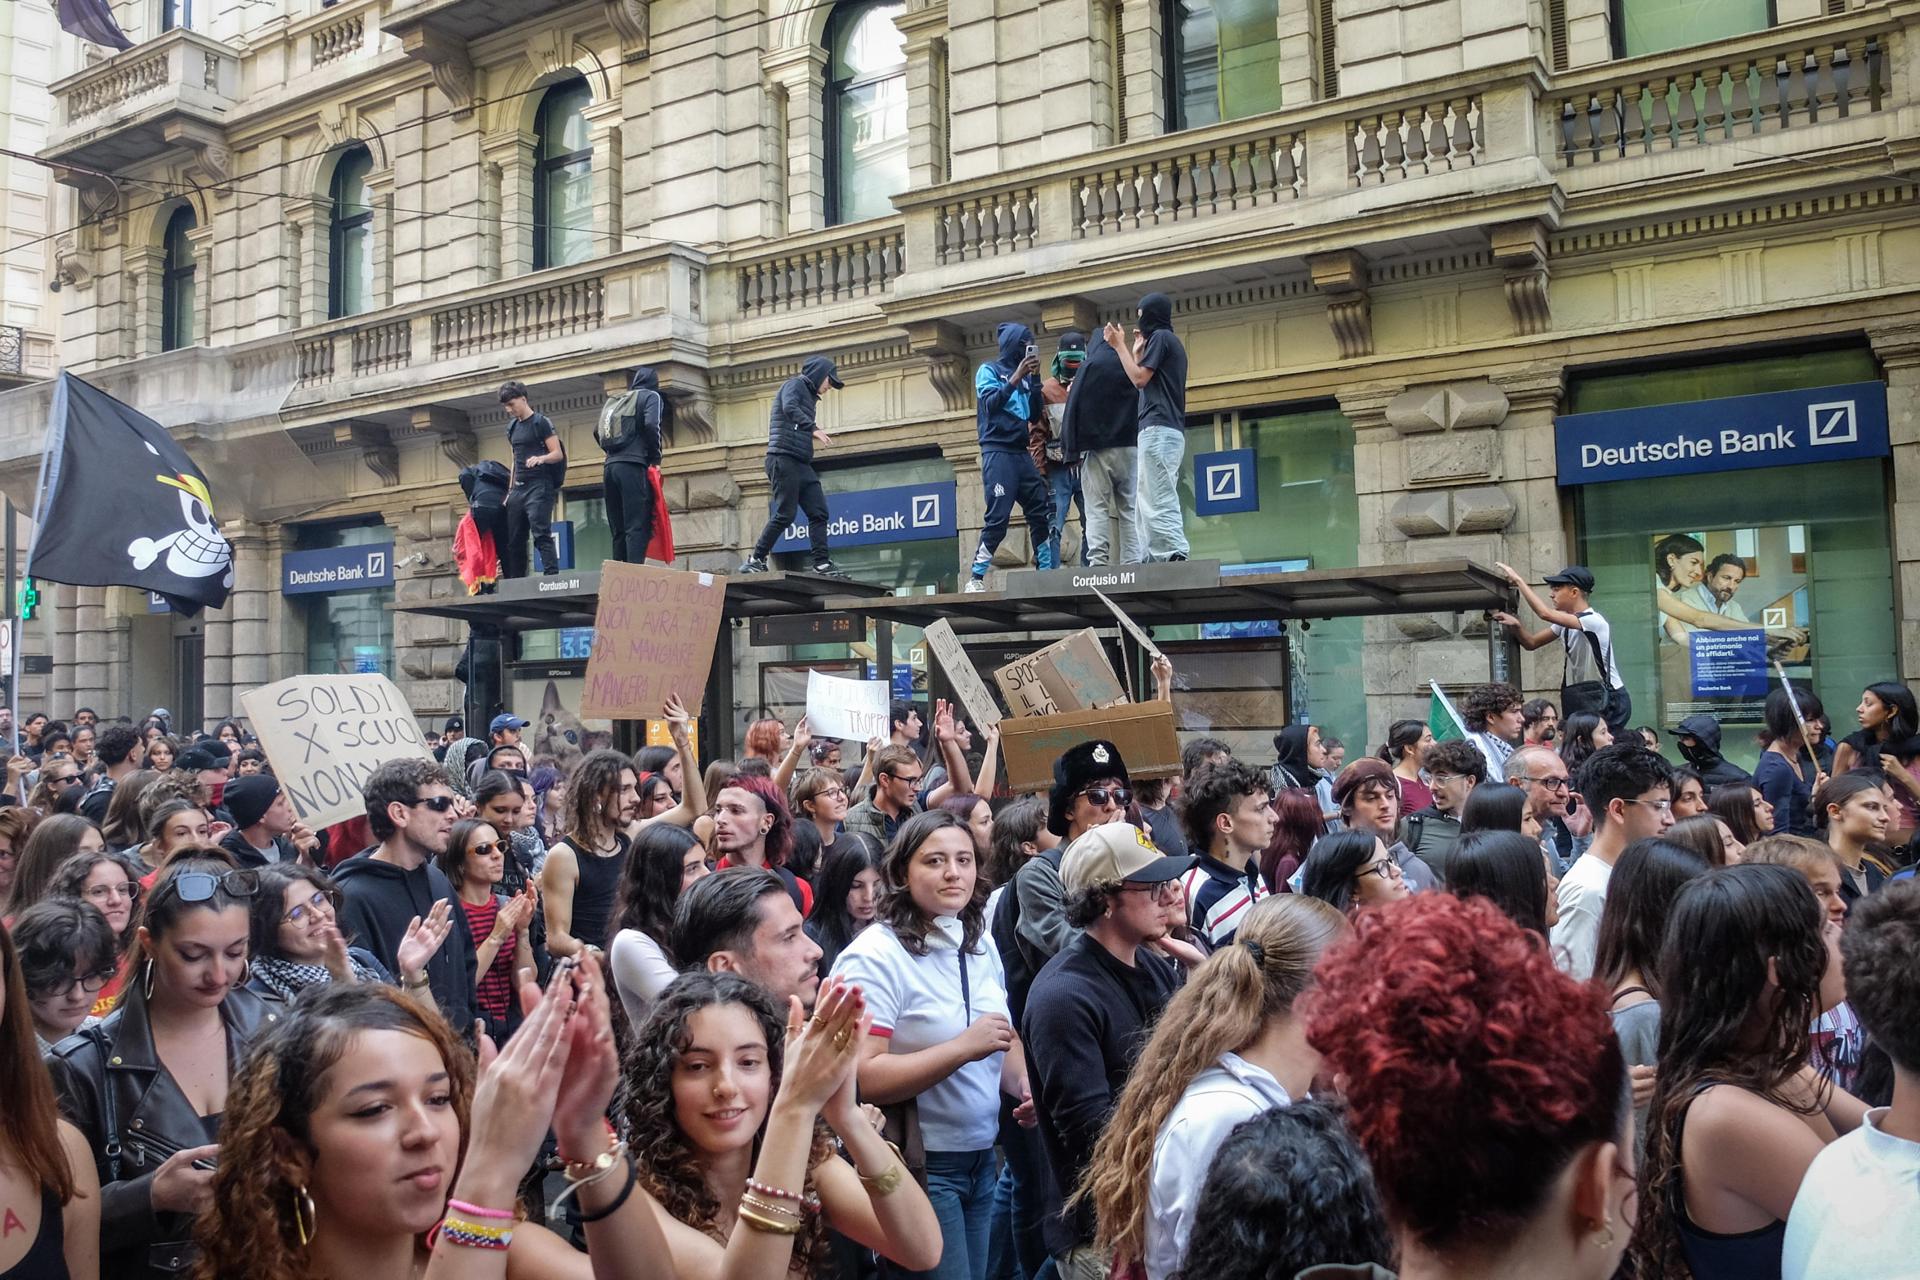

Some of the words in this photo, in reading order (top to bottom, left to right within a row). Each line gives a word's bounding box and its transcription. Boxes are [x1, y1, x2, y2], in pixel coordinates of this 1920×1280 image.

[1581, 435, 1712, 467] Deutsche
[1720, 425, 1796, 454] Bank
[862, 512, 905, 532] Bank
[290, 568, 336, 585] Deutsche
[338, 564, 364, 580] Bank
[539, 581, 569, 591] Cordusio
[569, 579, 580, 589] M1
[1072, 574, 1118, 587] Cordusio
[1120, 572, 1135, 584] M1
[608, 577, 669, 603] QUANDO
[598, 606, 632, 630] NON
[596, 636, 617, 664] DA
[1706, 643, 1743, 651] patrimonio
[277, 684, 393, 721] SOLDI
[1020, 693, 1036, 709] IL
[844, 708, 889, 739] TROPPO
[294, 723, 330, 764] X
